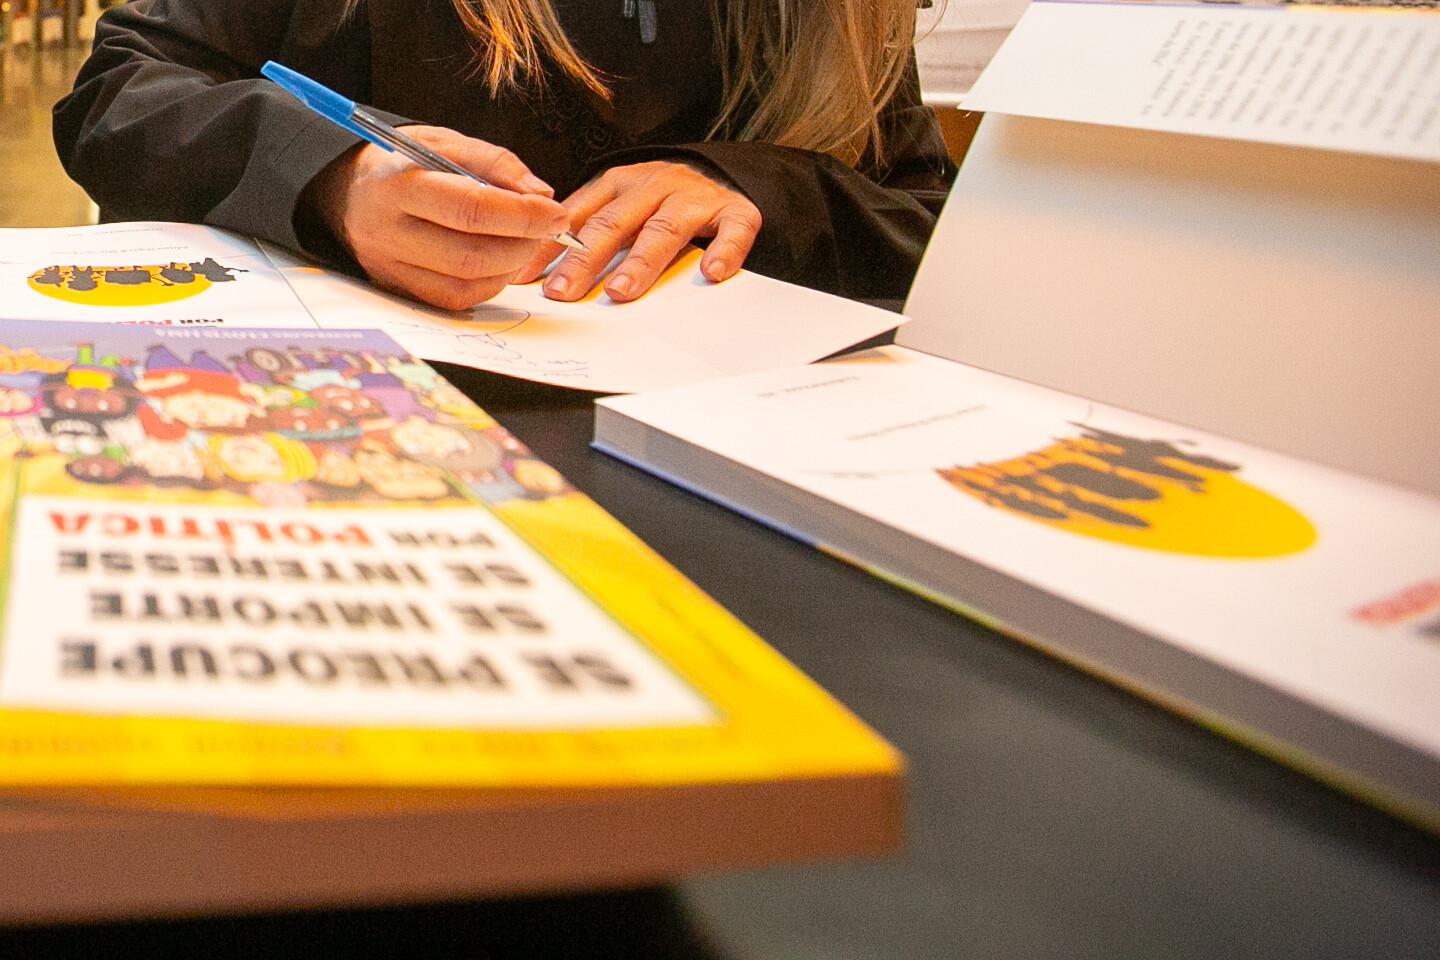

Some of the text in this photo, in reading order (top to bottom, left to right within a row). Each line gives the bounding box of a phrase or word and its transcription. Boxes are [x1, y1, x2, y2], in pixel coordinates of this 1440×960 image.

[48, 512, 496, 560] POR POLÍTICA
[56, 549, 529, 588] SE INTERESSE
[87, 591, 546, 636] SE IMPORTE
[55, 637, 635, 695] SE PREOCUPE
